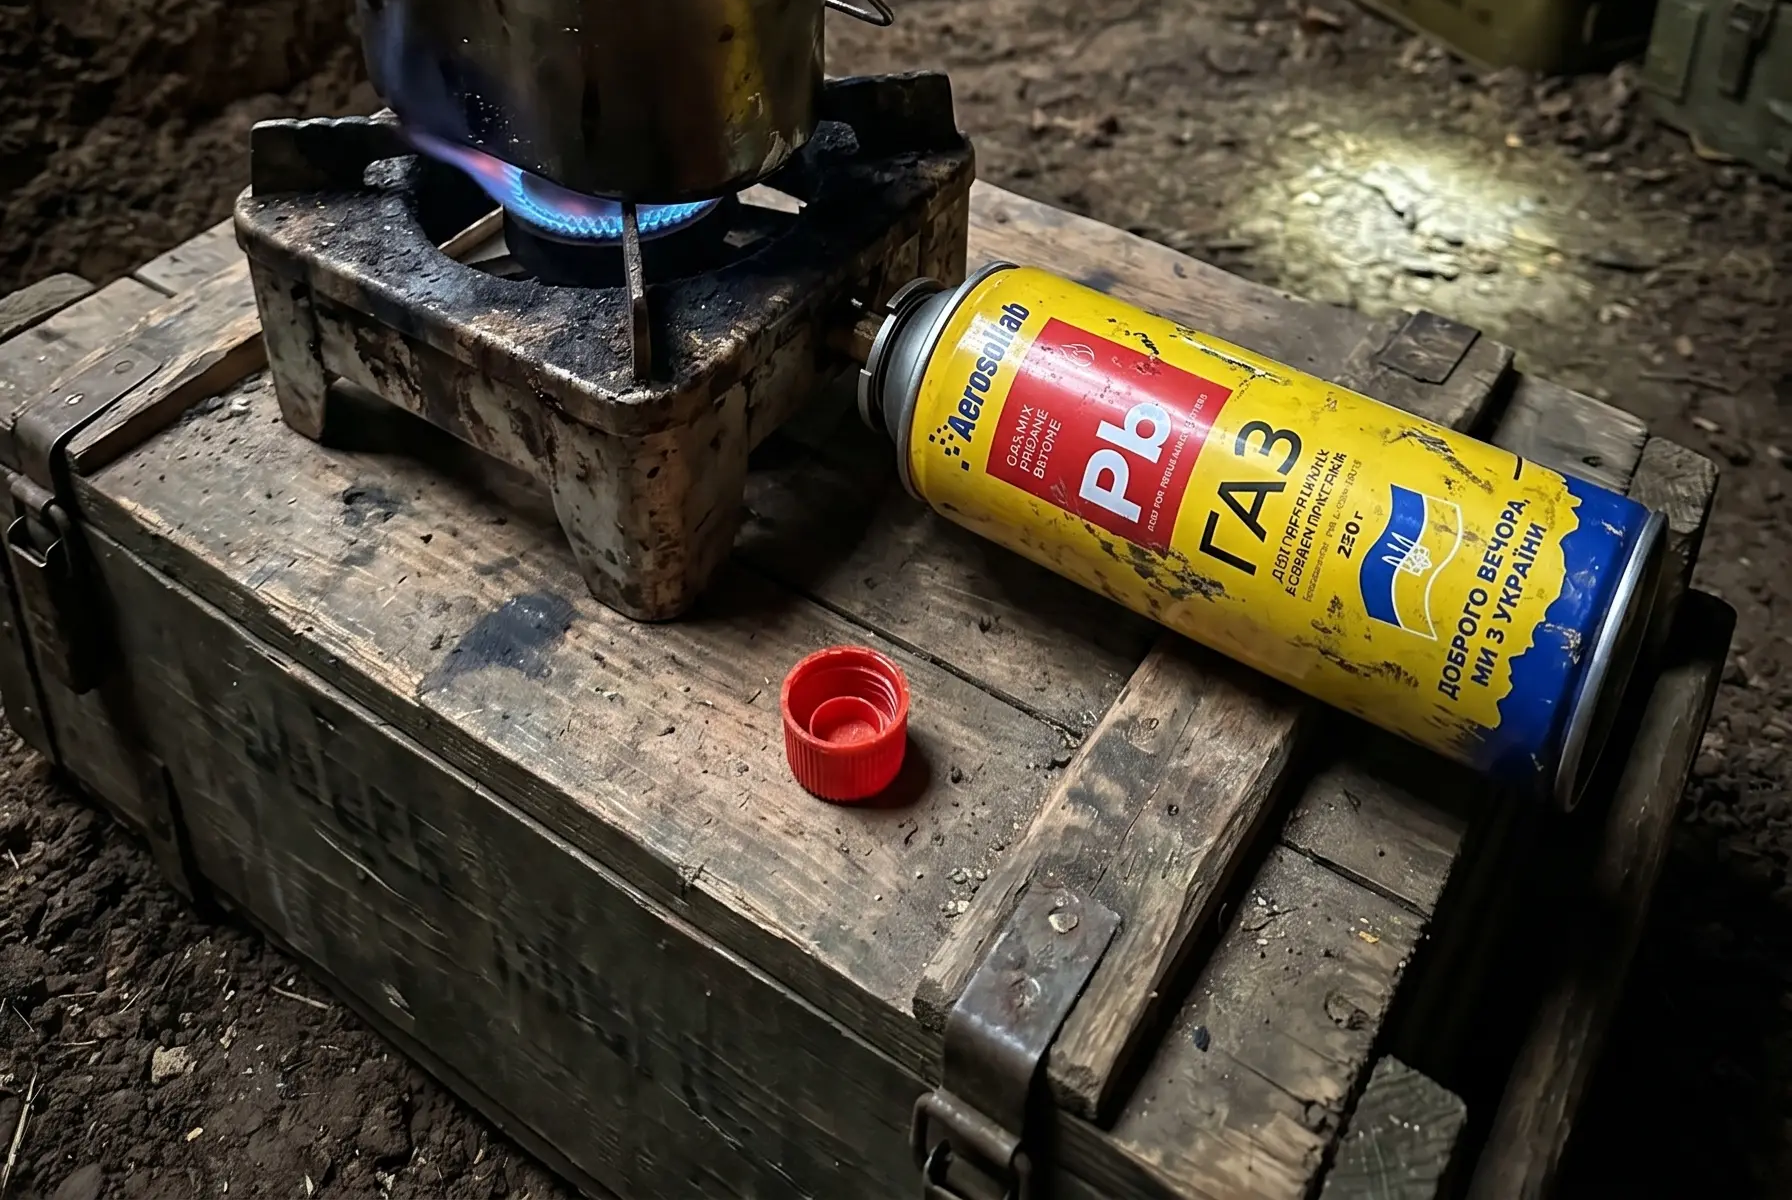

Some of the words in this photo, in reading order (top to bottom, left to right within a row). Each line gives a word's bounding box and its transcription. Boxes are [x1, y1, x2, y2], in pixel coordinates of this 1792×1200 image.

[947, 302, 1030, 443] Aerosollab
[1079, 402, 1172, 524] Pb
[1199, 420, 1302, 577] ГАЗ
[1438, 587, 1488, 701] ДОБРОГО
[1477, 499, 1532, 584] ВЕЧОРА,
[1470, 646, 1499, 688] МИ
[1492, 521, 1548, 624] УКРАЇНИ
